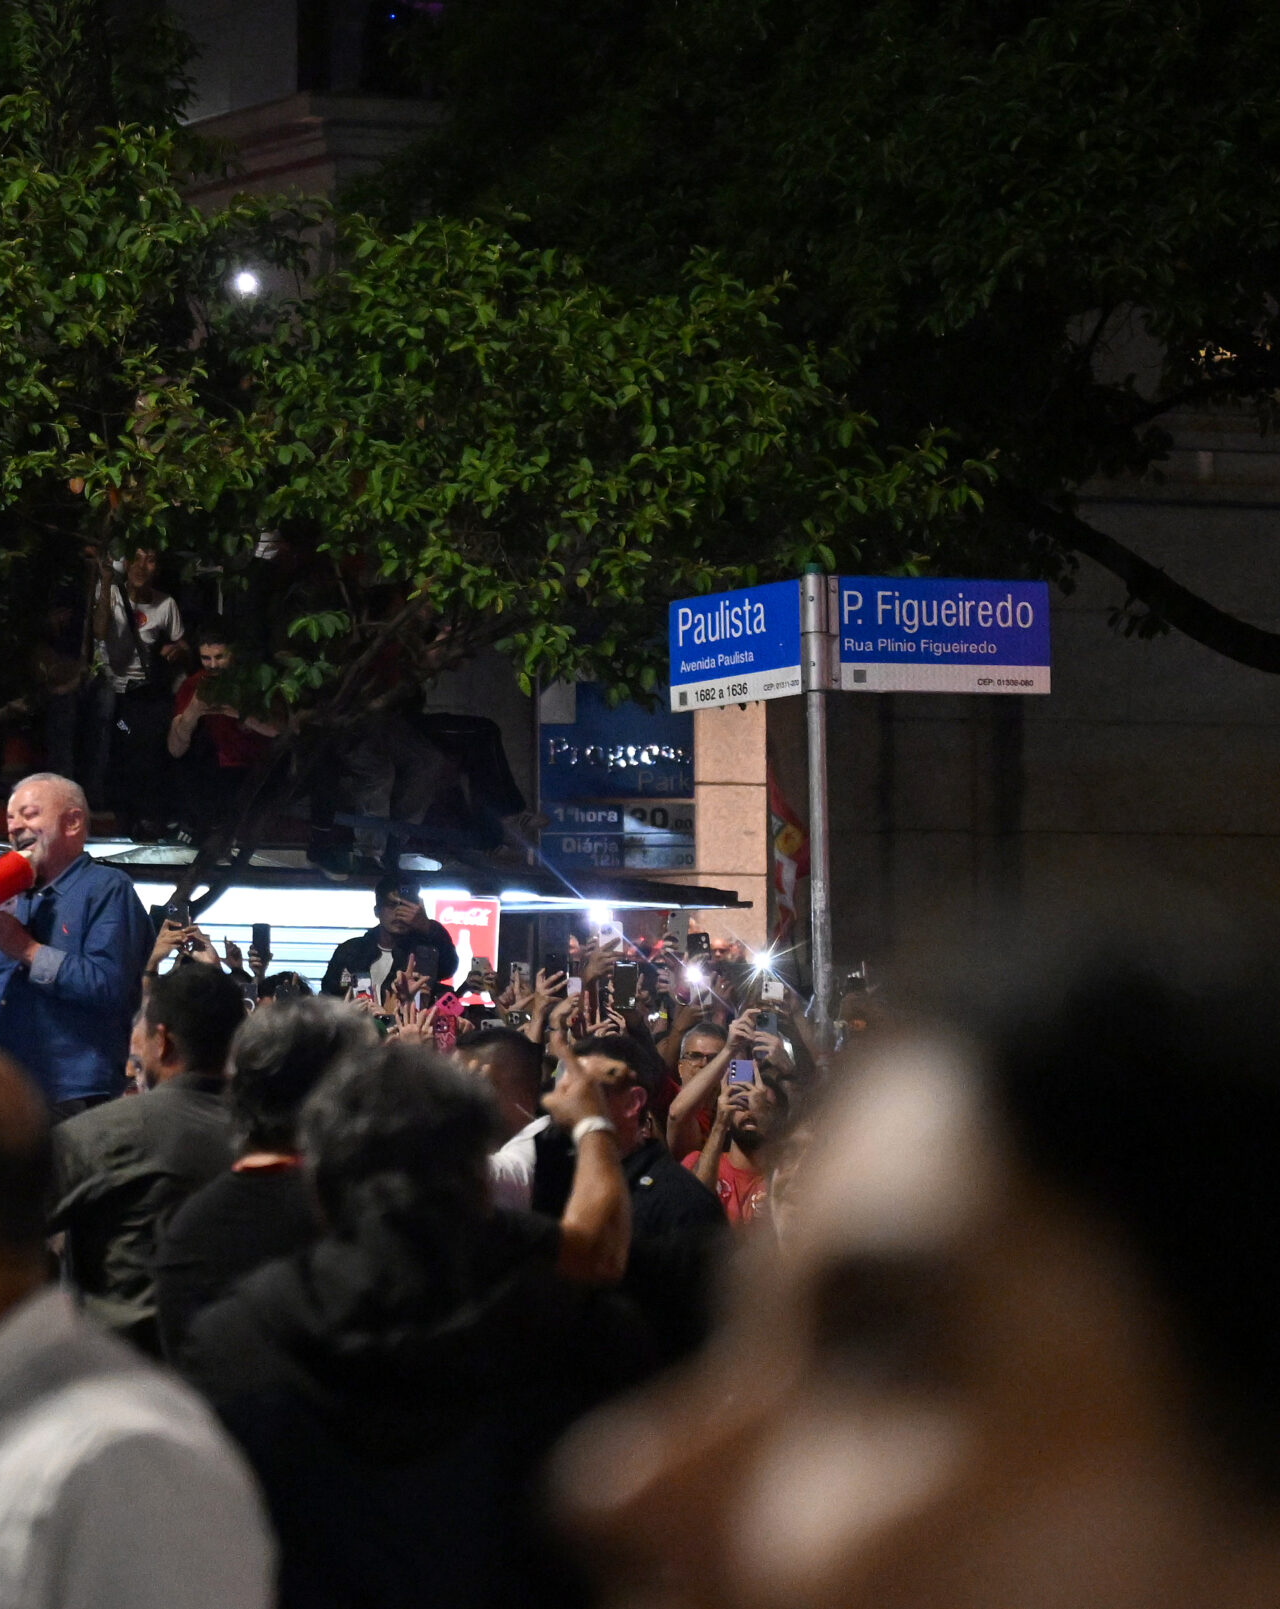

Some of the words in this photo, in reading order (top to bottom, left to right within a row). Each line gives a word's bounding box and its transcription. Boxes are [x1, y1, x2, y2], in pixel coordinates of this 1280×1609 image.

[677, 597, 767, 647] Paulista
[843, 590, 863, 625] P.
[877, 591, 1034, 633] Figueiredo
[844, 638, 874, 653] Rua
[877, 637, 916, 653] Plínio
[920, 638, 997, 657] Figueiredo
[680, 658, 717, 675] Avenida
[718, 650, 755, 668] Paulista
[694, 686, 718, 702] 1682
[718, 688, 726, 699] a
[726, 682, 749, 698] 1636
[637, 769, 692, 792] Park
[561, 837, 619, 854] Diária
